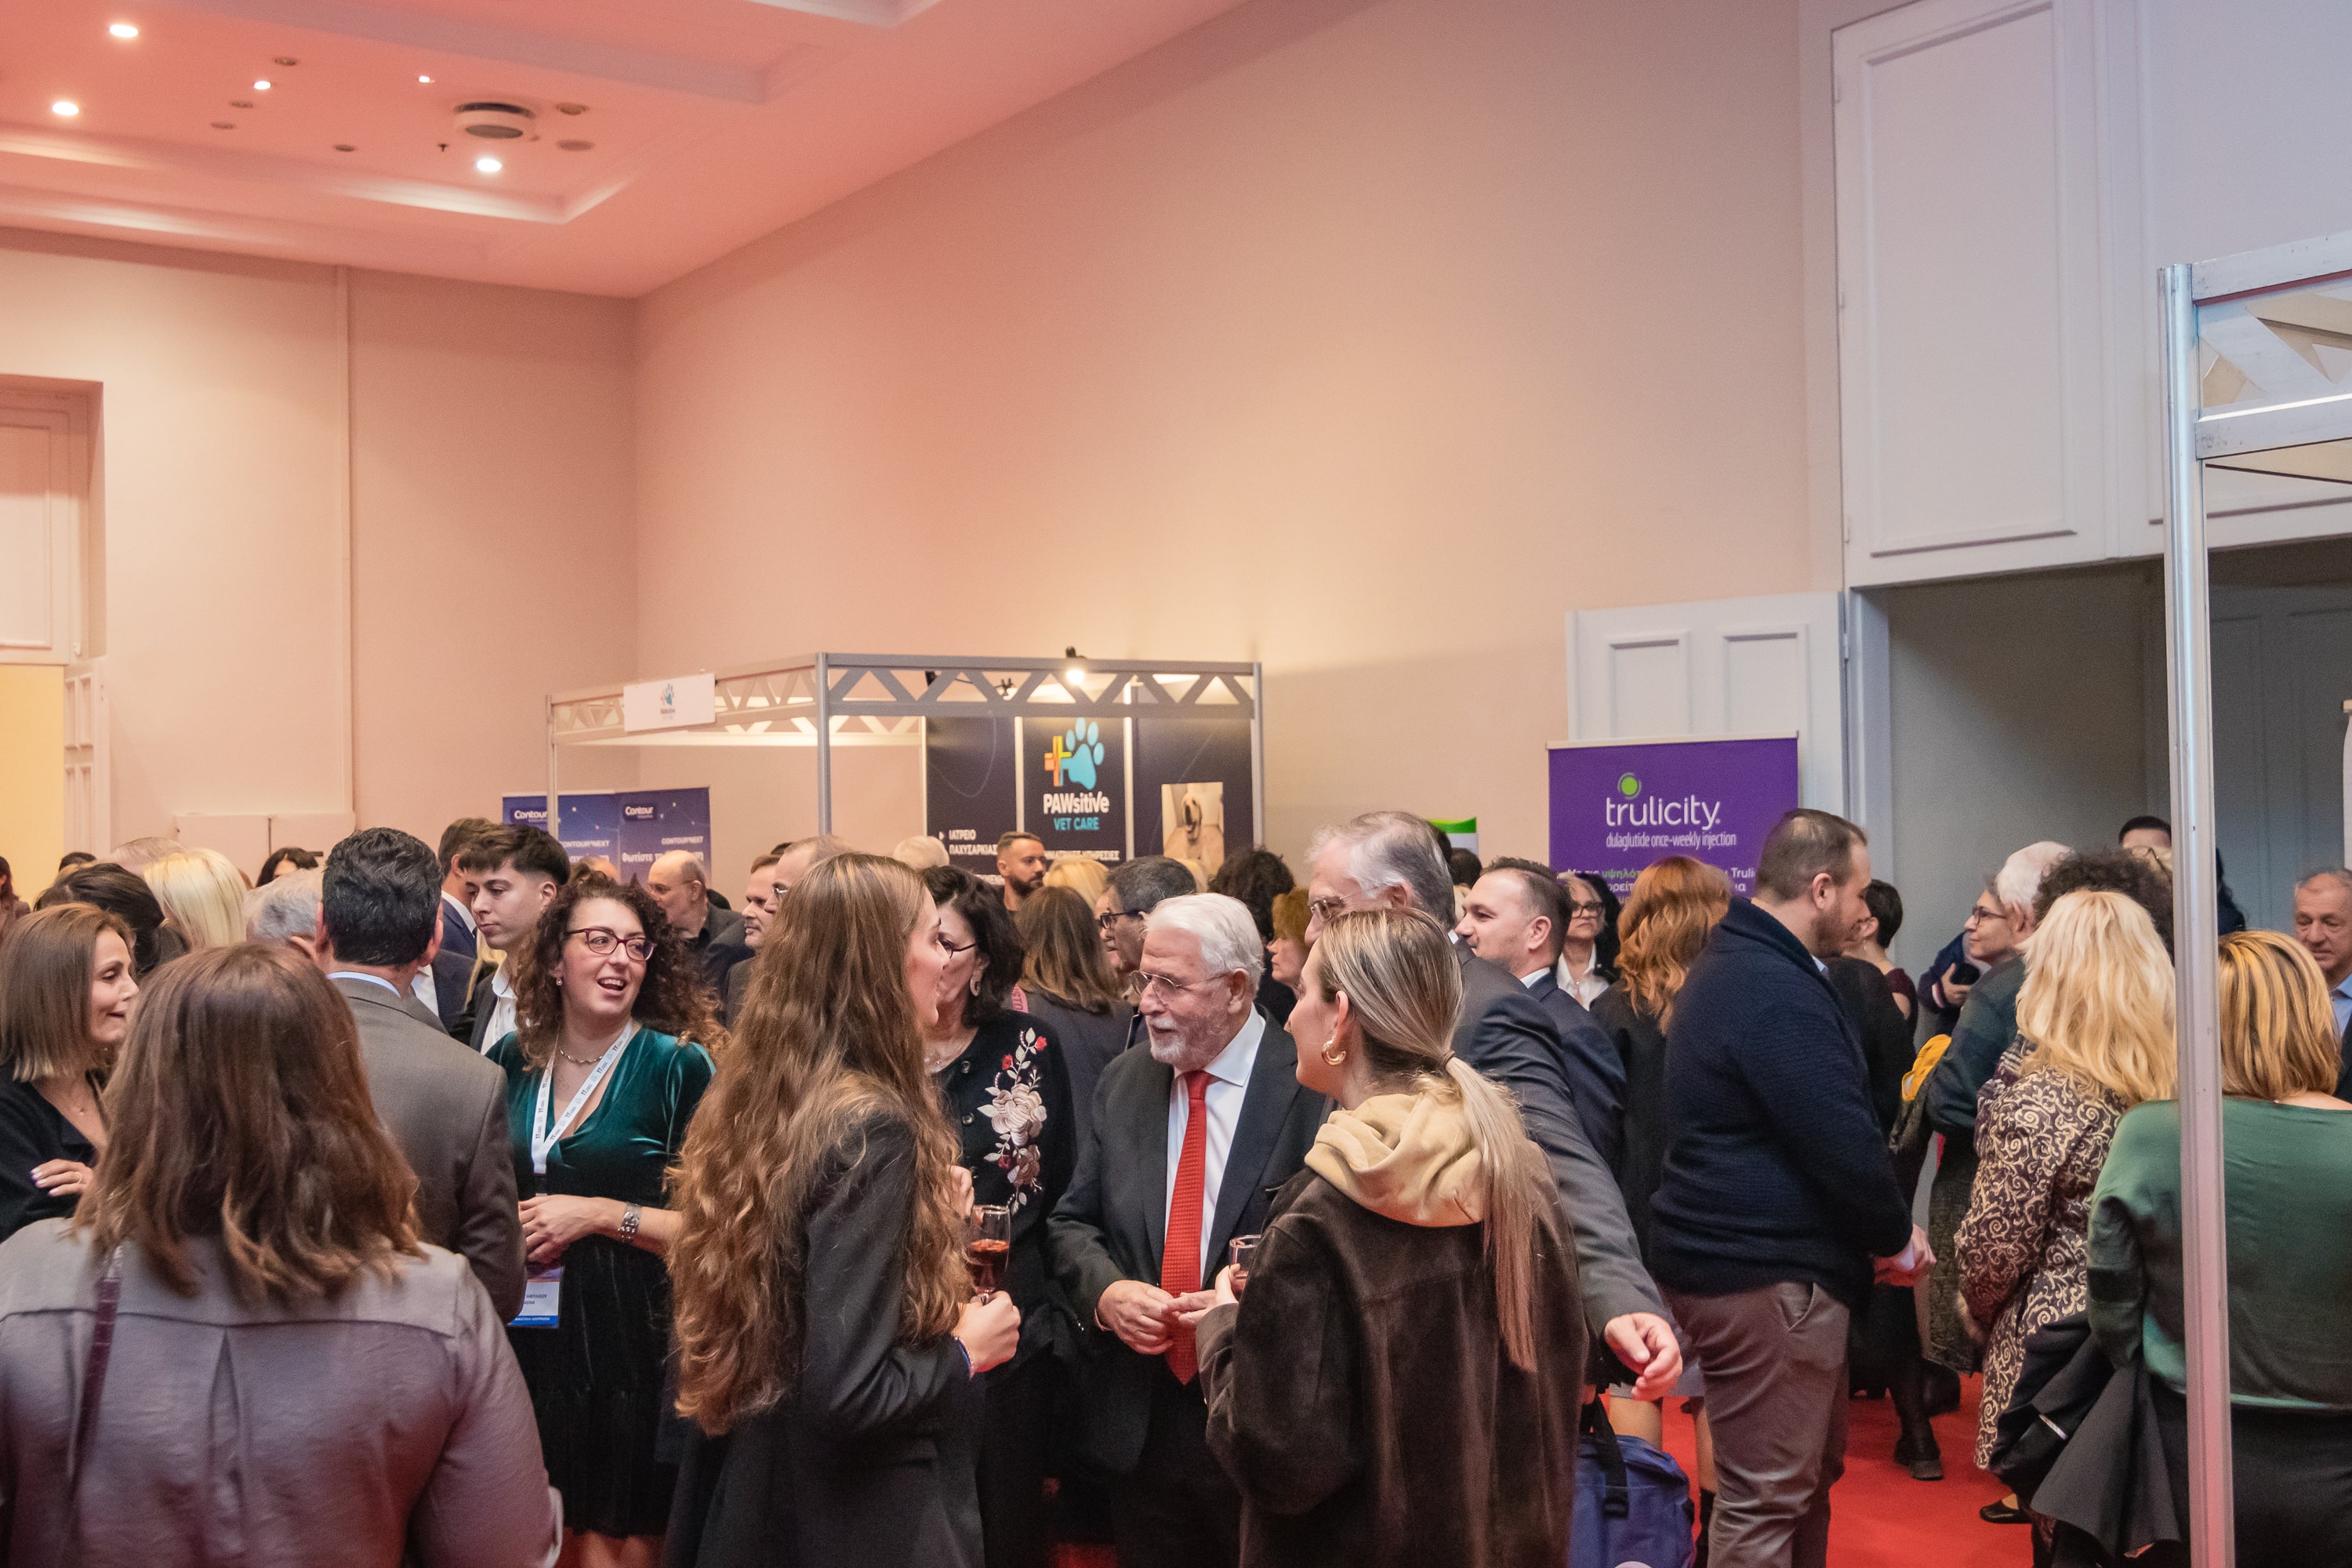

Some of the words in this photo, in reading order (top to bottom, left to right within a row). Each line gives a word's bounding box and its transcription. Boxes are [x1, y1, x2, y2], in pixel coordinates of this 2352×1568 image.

[1043, 790, 1110, 814] PAWsitive
[625, 806, 654, 815] Contour
[1053, 817, 1072, 831] VET
[1073, 817, 1100, 830] CARE
[1606, 832, 1650, 851] dulaglutide
[1651, 831, 1700, 851] once-weekly
[1701, 831, 1737, 851] injection
[1730, 867, 1756, 878] Truli
